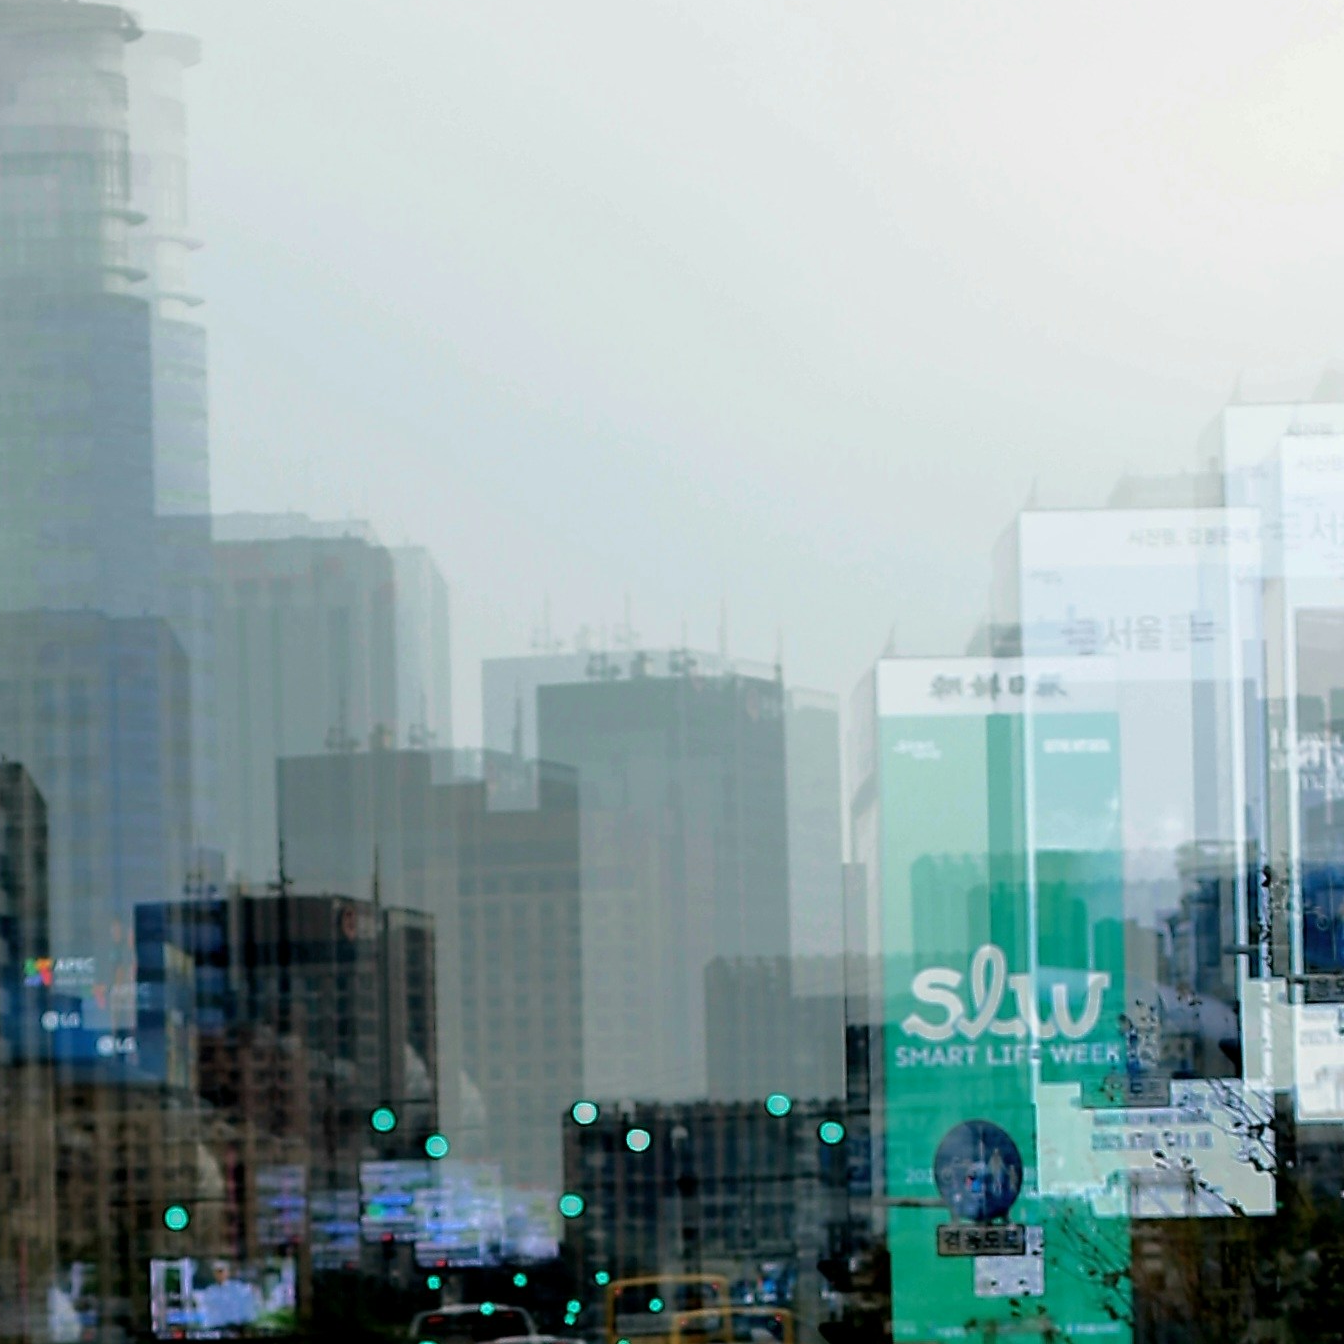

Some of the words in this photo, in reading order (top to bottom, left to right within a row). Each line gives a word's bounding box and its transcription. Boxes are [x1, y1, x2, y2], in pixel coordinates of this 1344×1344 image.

[895, 1045, 976, 1067] SMART
[987, 1045, 1040, 1065] LIFE
[1050, 1043, 1120, 1064] WEEK
